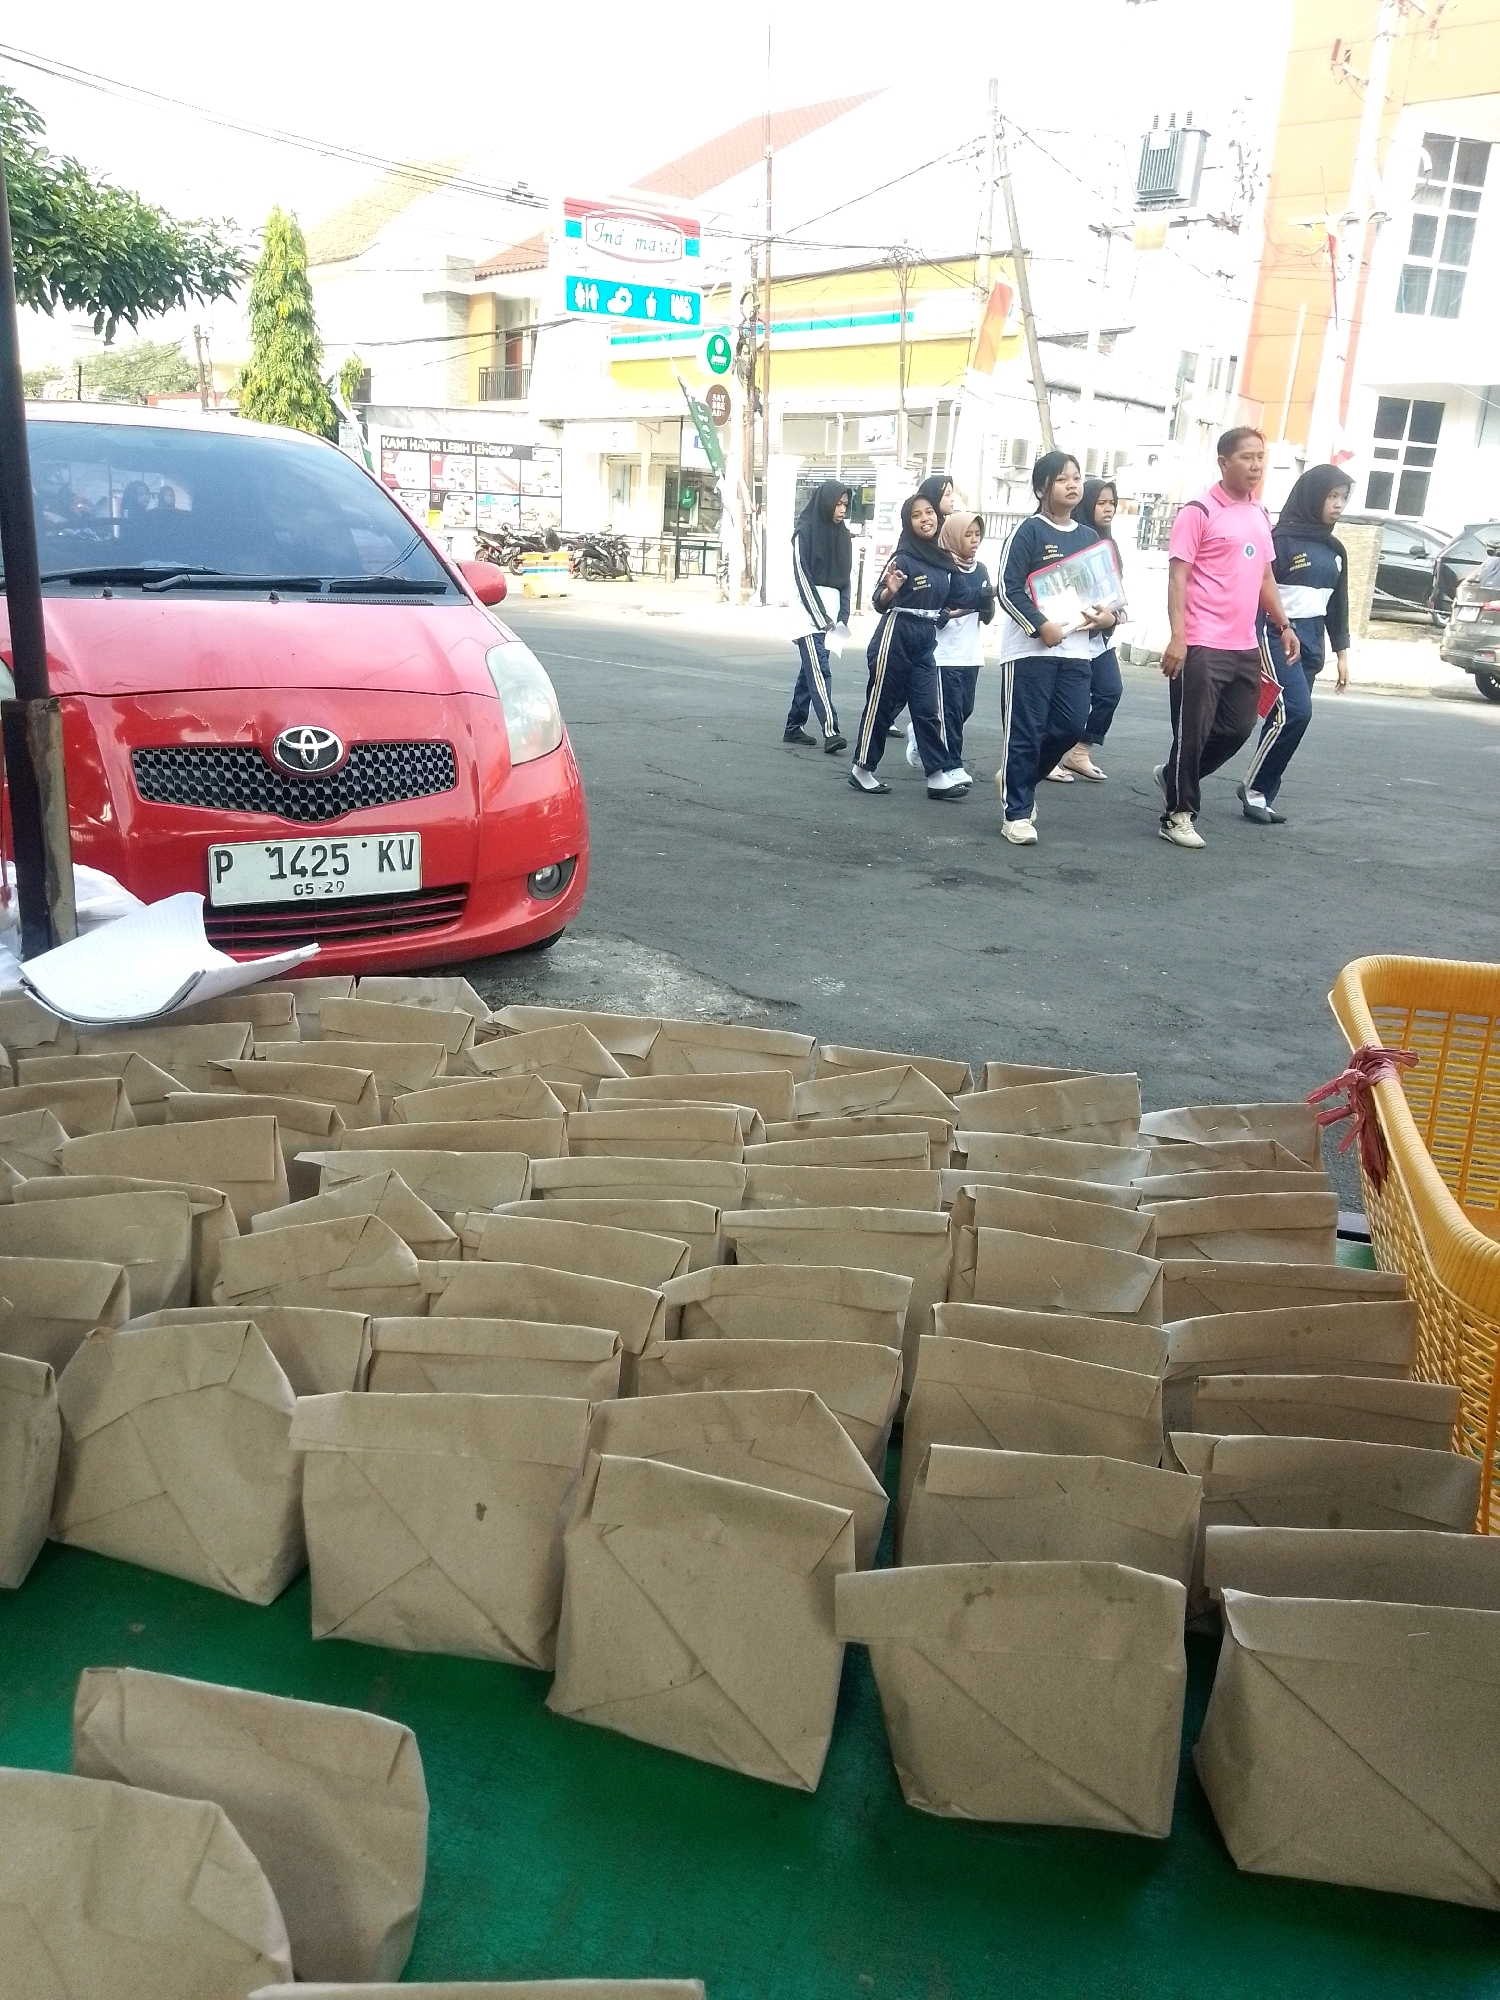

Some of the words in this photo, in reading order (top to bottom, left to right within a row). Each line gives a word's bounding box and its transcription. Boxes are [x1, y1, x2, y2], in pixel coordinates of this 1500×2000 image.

[590, 222, 678, 255] Indmaret
[712, 393, 726, 402] SAY
[381, 436, 408, 450] KAMI
[410, 438, 441, 453] HADIR
[442, 441, 470, 455] LEBIH
[472, 444, 514, 457] LENGKAP
[213, 849, 234, 884] P
[268, 842, 350, 880] 1425
[378, 838, 415, 873] KV
